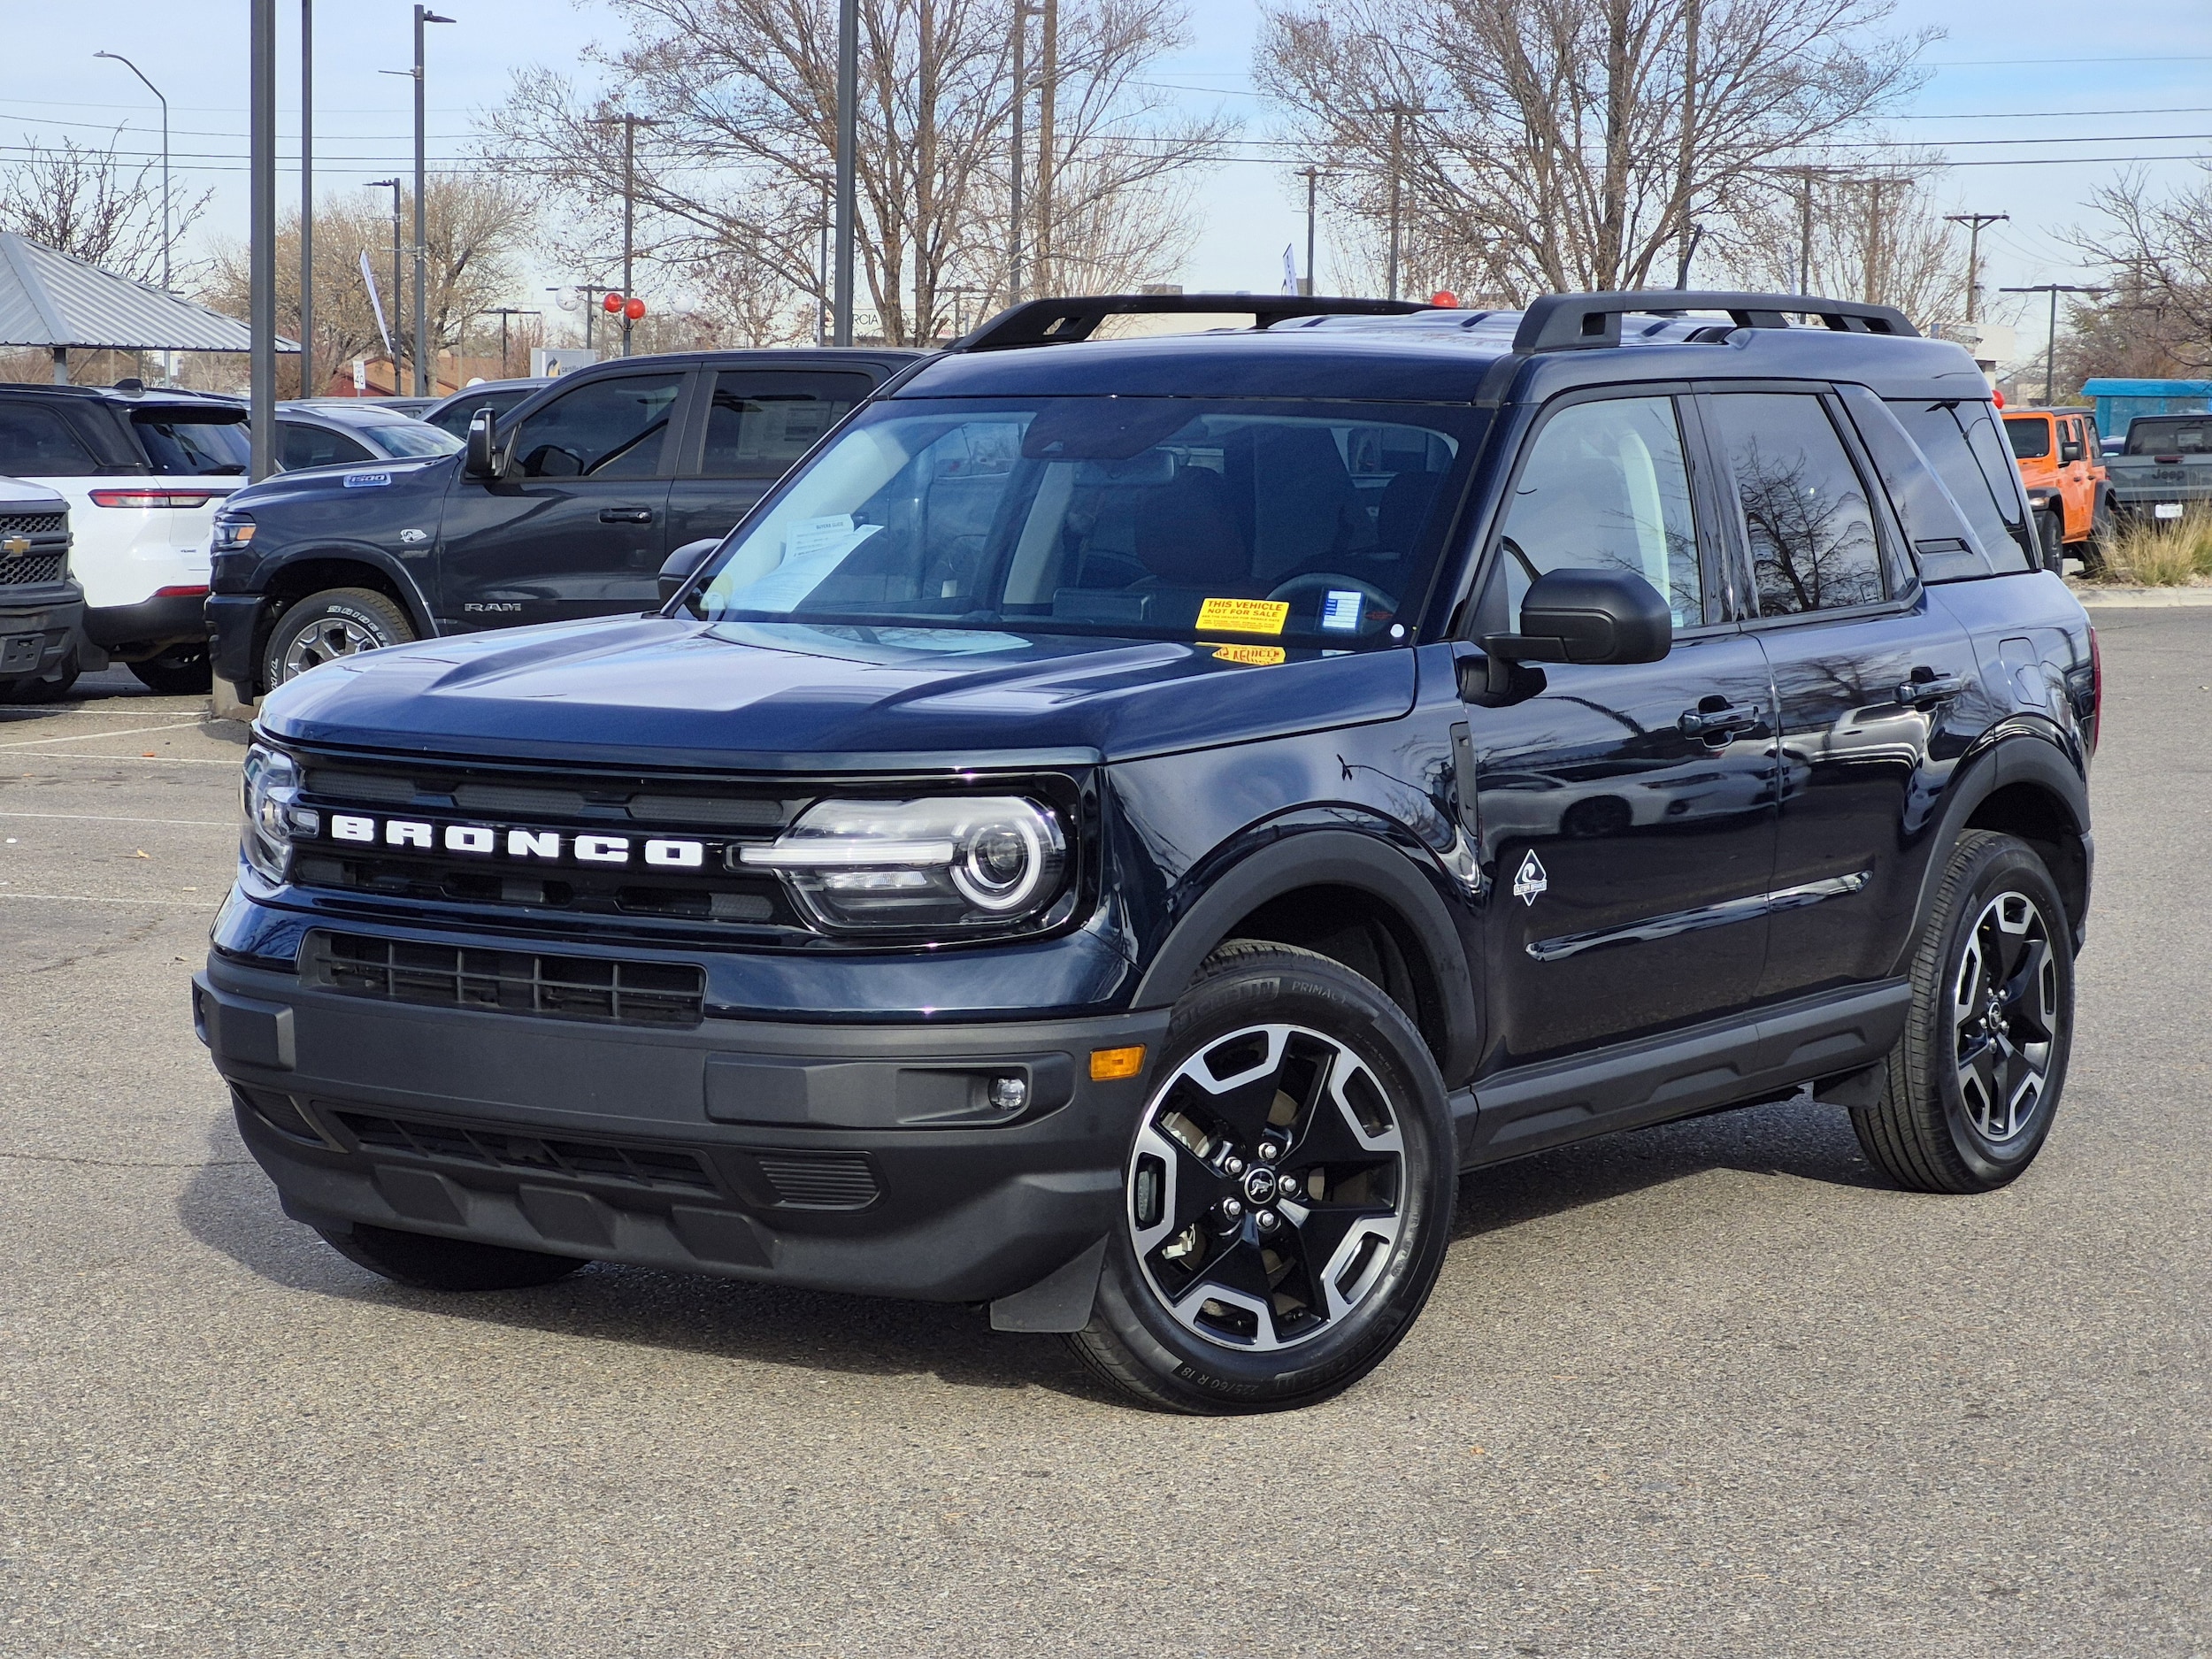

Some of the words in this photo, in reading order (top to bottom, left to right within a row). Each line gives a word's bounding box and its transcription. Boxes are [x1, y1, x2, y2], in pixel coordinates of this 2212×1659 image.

[355, 374, 364, 385] 40
[2152, 468, 2185, 480] Jeep
[465, 603, 521, 611] RAM
[1236, 602, 1283, 611] VEHICLE
[331, 815, 703, 866] BRONCO
[1291, 980, 1347, 1005] PRIMACY
[1180, 1367, 1194, 1378] 18
[1196, 1373, 1210, 1384] R
[1210, 1379, 1259, 1395] 225/60
